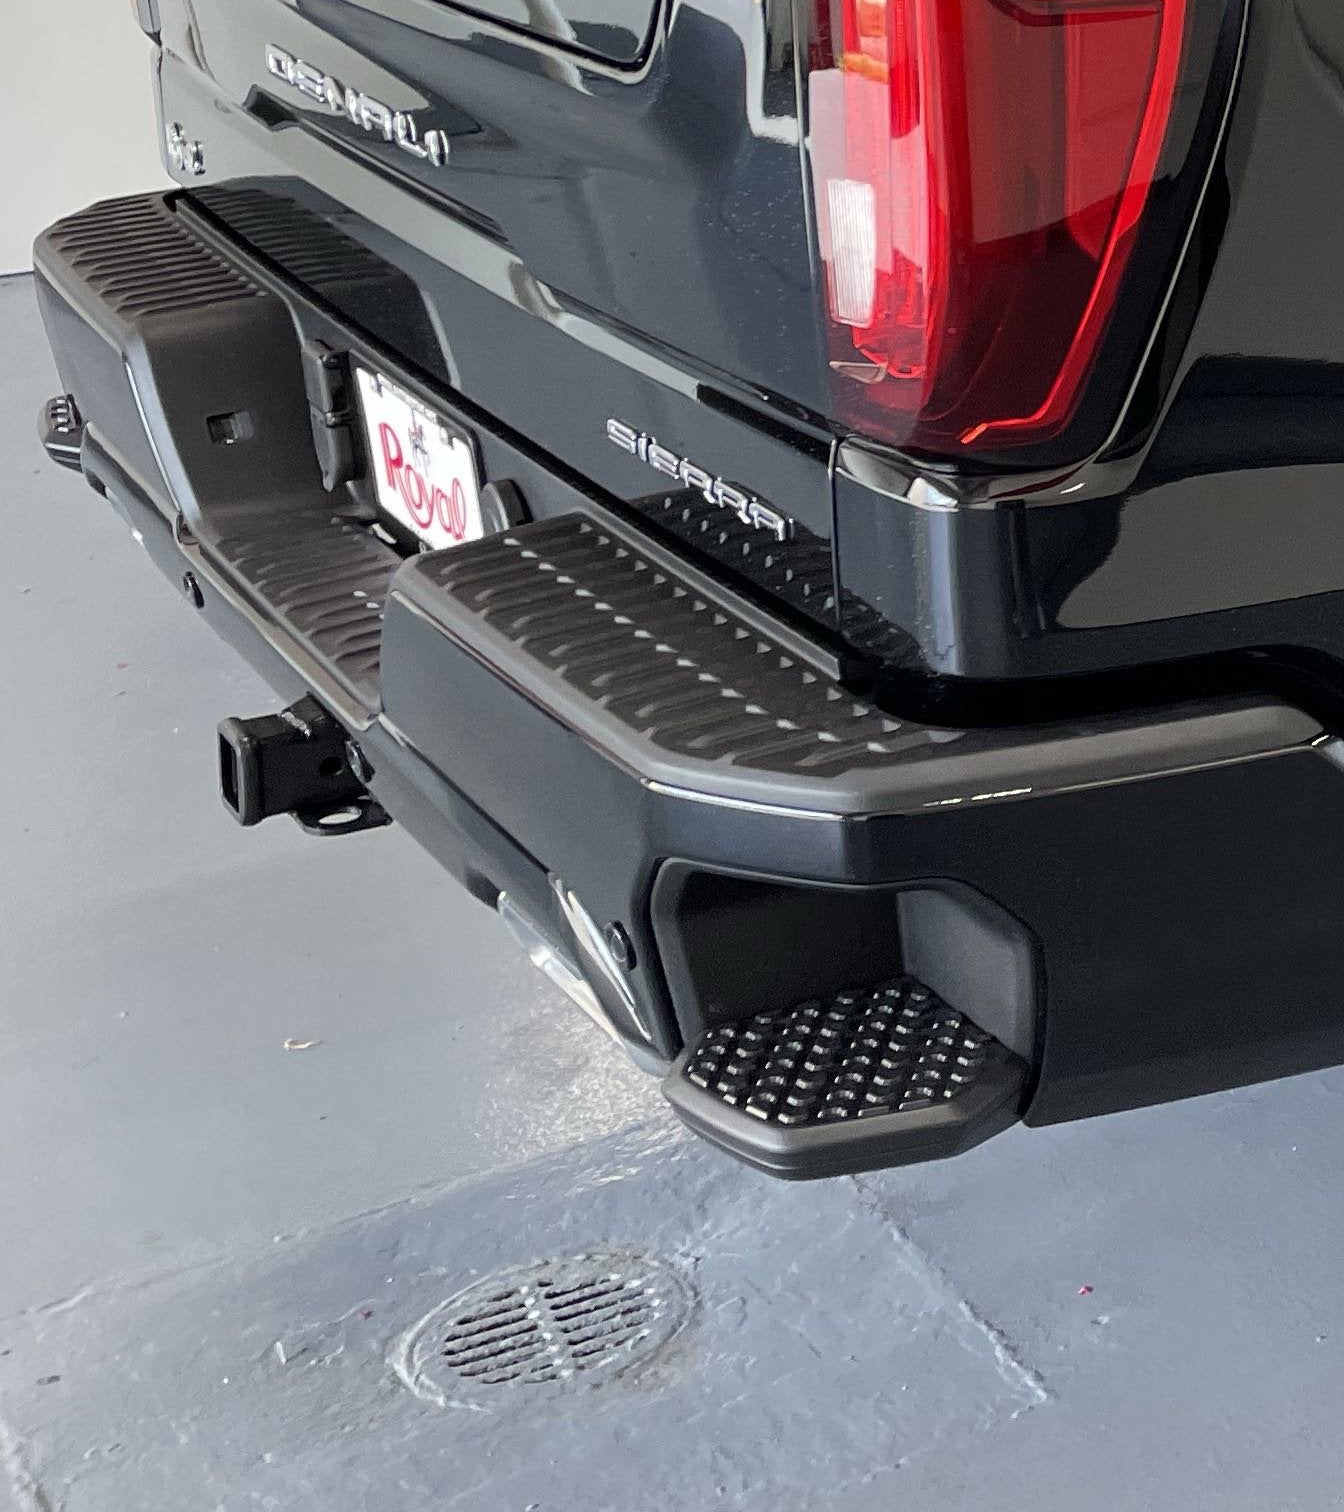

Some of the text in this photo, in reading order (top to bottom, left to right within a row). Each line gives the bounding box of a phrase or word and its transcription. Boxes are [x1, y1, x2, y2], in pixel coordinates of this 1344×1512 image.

[265, 44, 447, 168] DENALI
[378, 421, 467, 541] Royal
[606, 418, 788, 542] SIERRA
